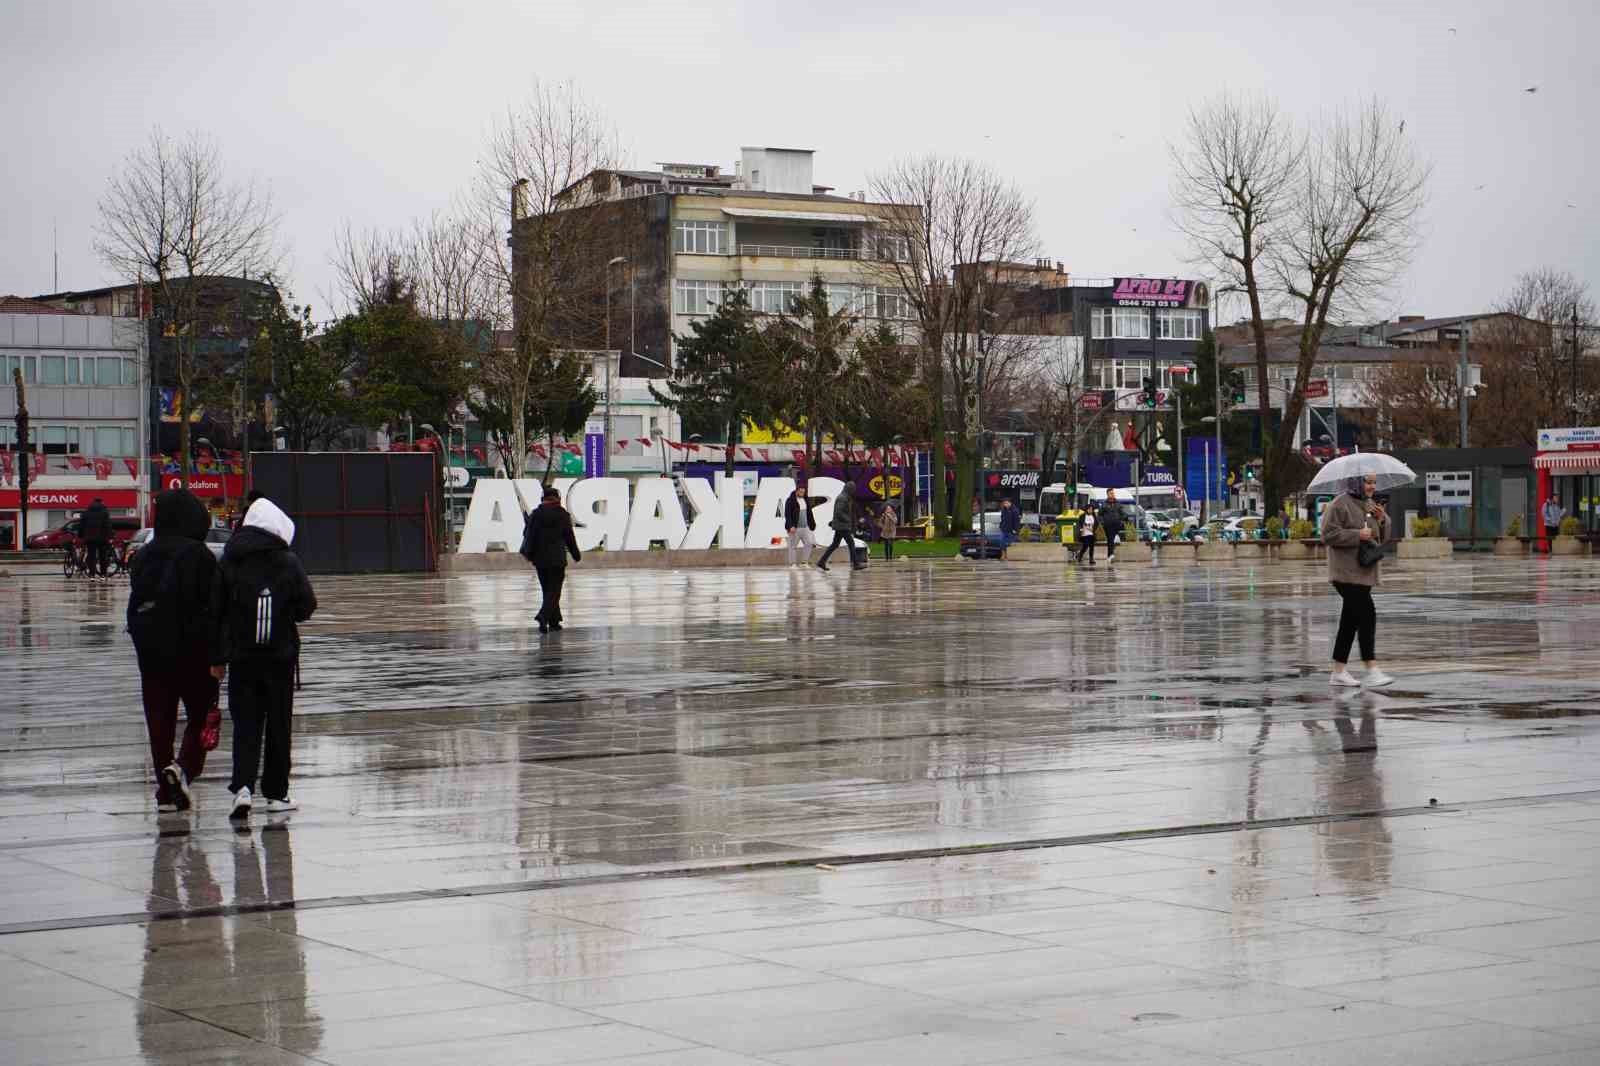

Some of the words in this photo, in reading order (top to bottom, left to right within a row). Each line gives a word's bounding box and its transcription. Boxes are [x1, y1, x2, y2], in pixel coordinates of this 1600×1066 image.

[1116, 279, 1161, 293] AFRO
[188, 479, 219, 489] odafone
[873, 479, 904, 490] grtis
[1001, 472, 1040, 488] arçelik
